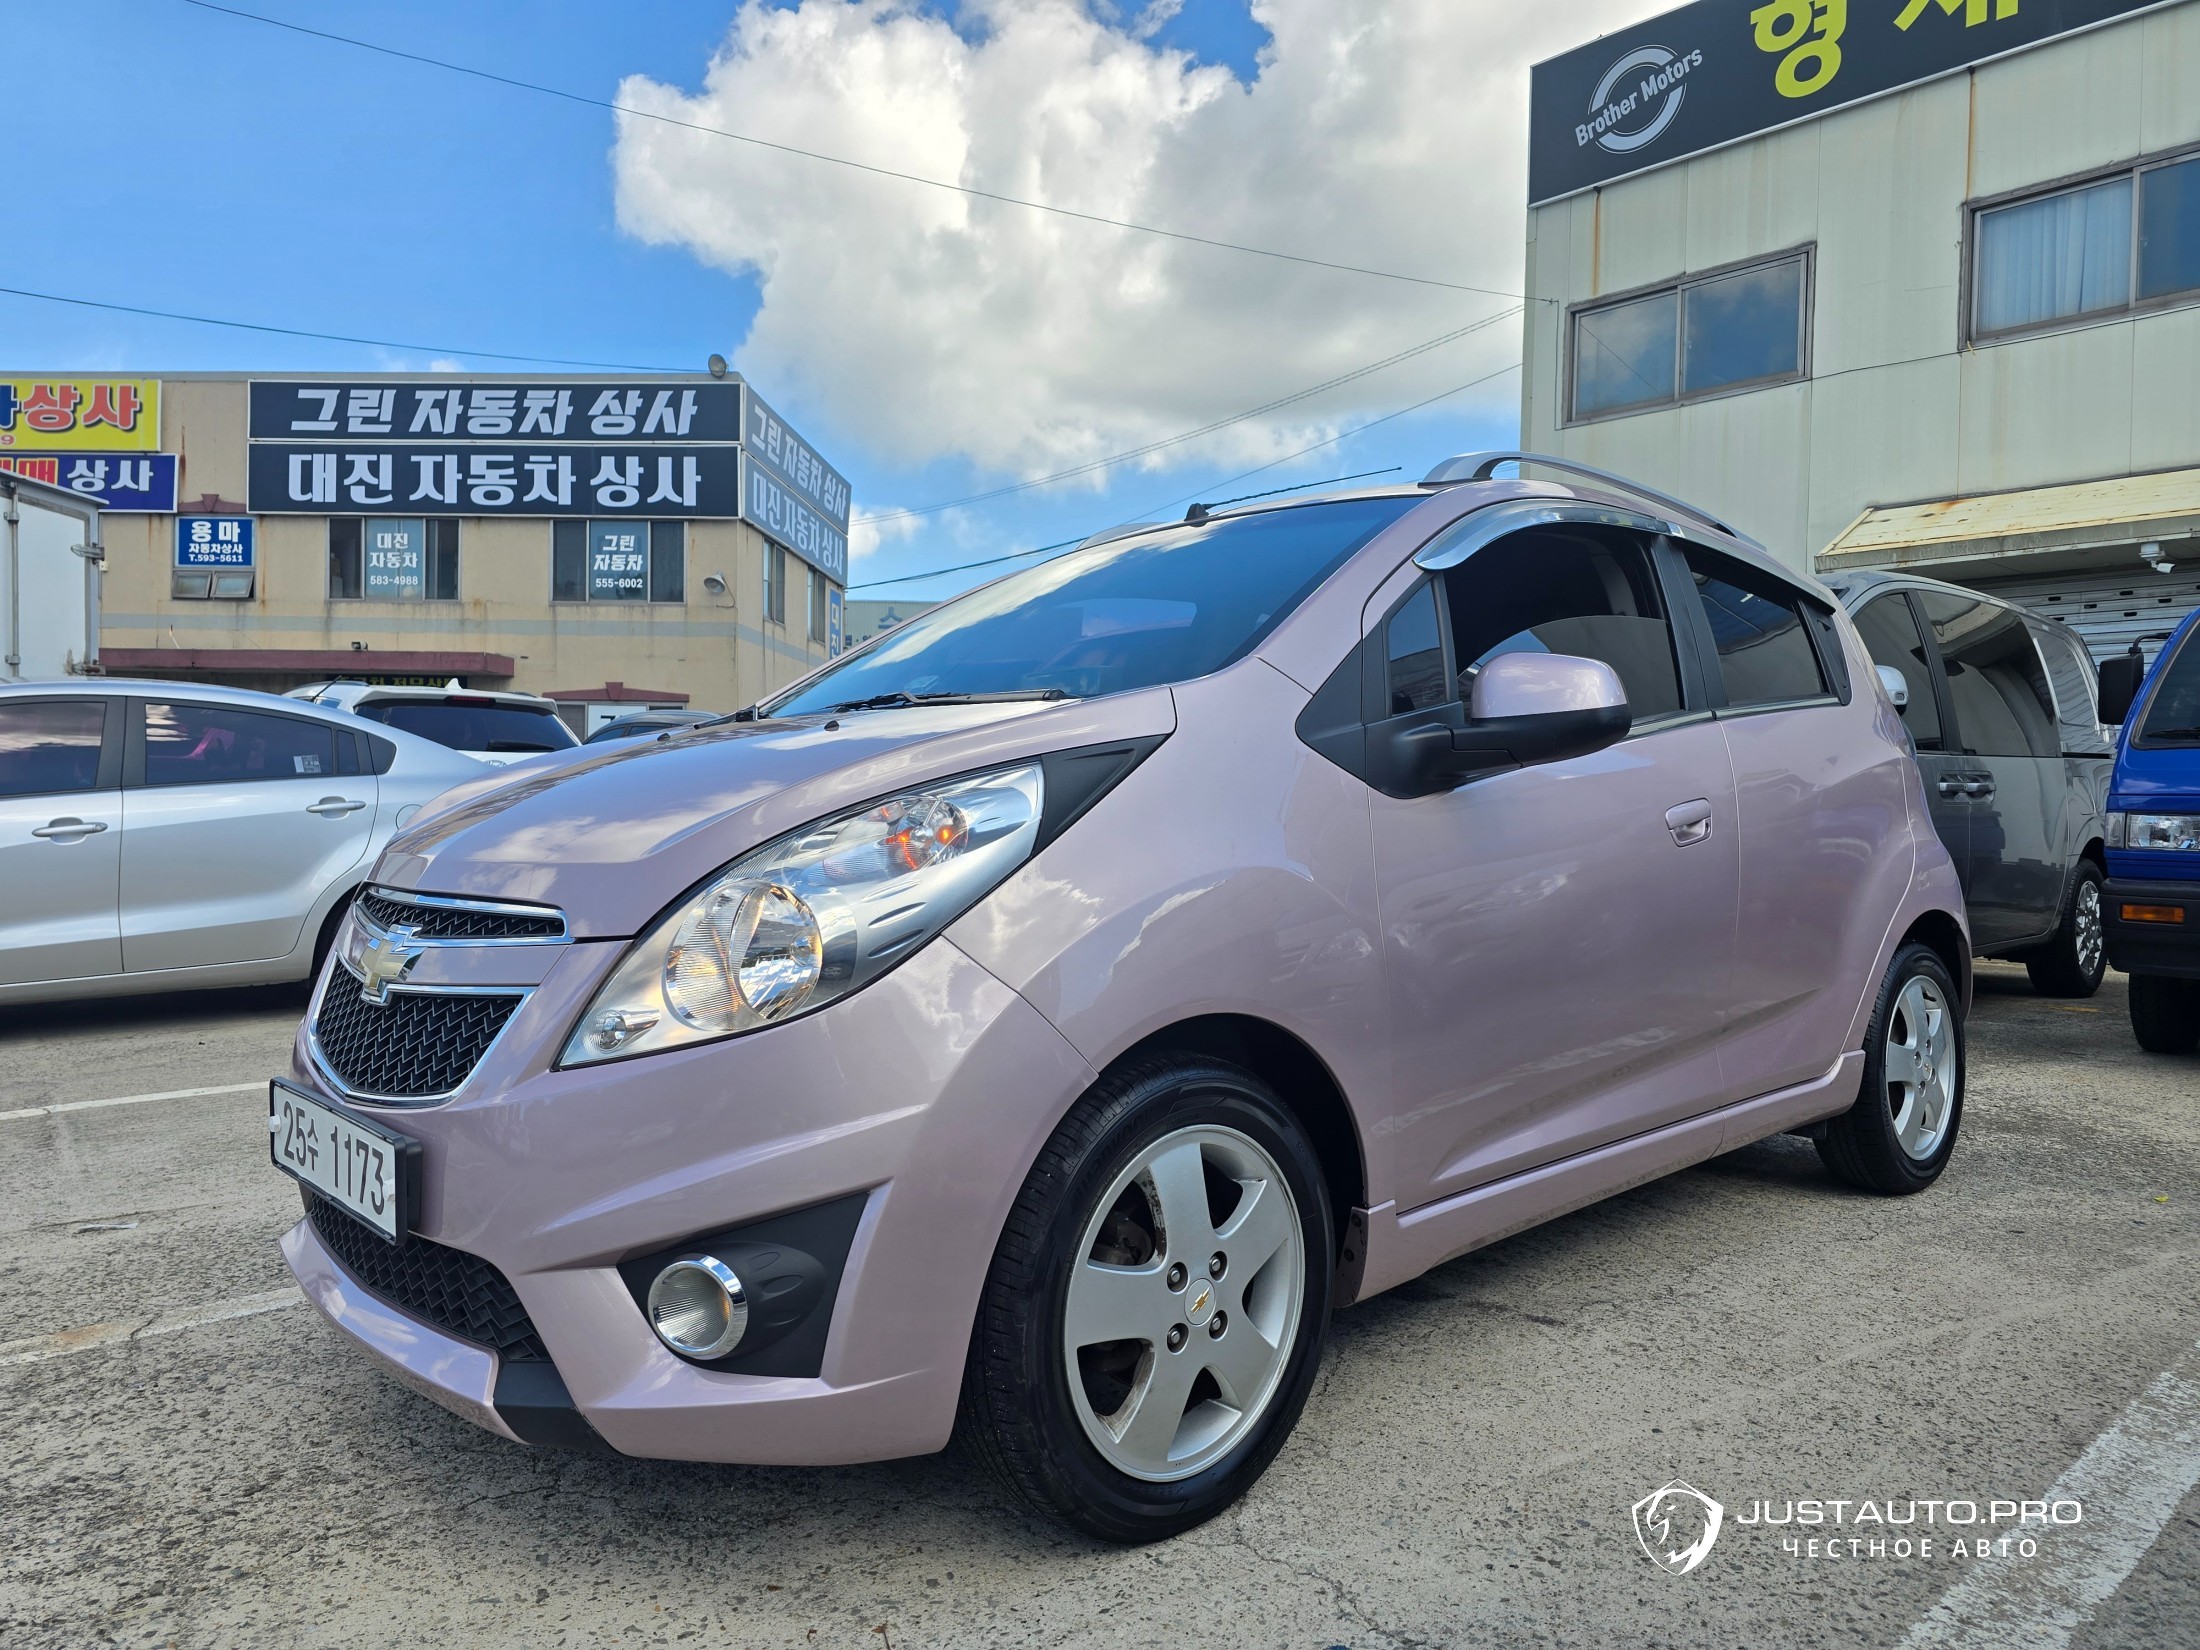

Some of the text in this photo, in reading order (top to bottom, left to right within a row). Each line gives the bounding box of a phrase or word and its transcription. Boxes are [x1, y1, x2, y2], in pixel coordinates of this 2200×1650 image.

[1575, 49, 1703, 147] Brother Motors
[0, 383, 141, 431] 상사
[291, 389, 698, 435] 그린 자동차 상사
[752, 404, 847, 521] 그린 자동차 상사
[66, 459, 154, 492] 상사
[288, 453, 702, 507] 대진 자동차 상사
[753, 470, 844, 575] 대진 자동차 상사
[188, 543, 243, 554] 자동차상사
[377, 532, 409, 549] 대진
[602, 535, 635, 551] 그린
[188, 554, 243, 562] T.593-5611
[369, 551, 419, 569] 자동차
[593, 554, 643, 571] 자동차
[370, 575, 419, 585] 583-4988
[595, 578, 643, 588] 555-6002
[283, 1100, 385, 1216] 25수 1173
